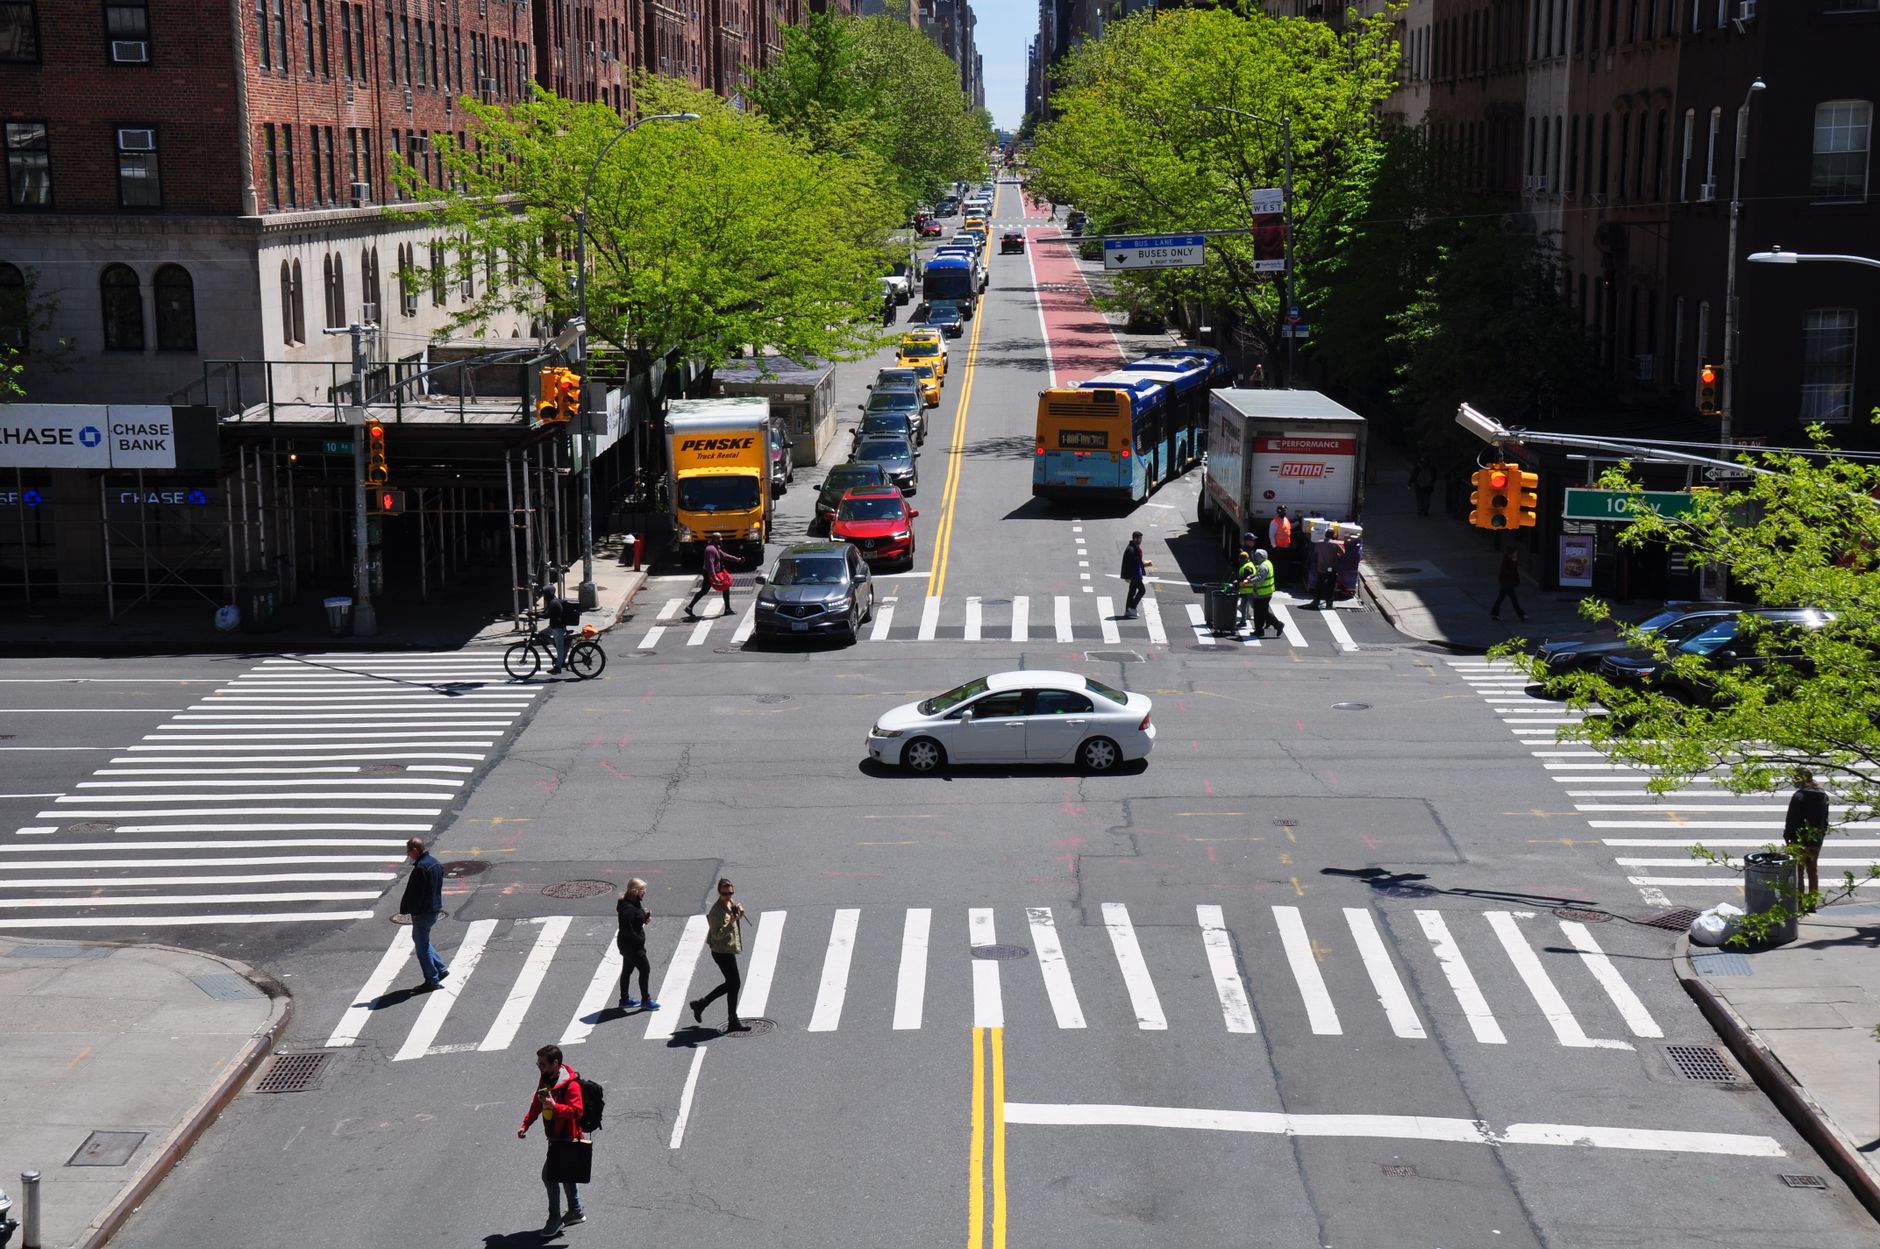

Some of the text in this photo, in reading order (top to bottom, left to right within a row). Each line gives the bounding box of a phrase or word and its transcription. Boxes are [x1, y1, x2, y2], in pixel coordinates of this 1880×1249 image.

[1253, 204, 1281, 212] WEST
[1134, 238, 1174, 248] BUS LANE
[1138, 247, 1194, 258] BUSES ONLY
[113, 424, 169, 435] CHASE
[0, 428, 75, 445] HASE
[119, 439, 166, 451] BANK
[326, 442, 337, 452] 10
[680, 437, 755, 452] PENSKE
[1281, 440, 1339, 448] PERFORMANCE
[1281, 464, 1322, 476] ROMA
[120, 492, 184, 504] CHASE
[1606, 497, 1628, 513] 10
